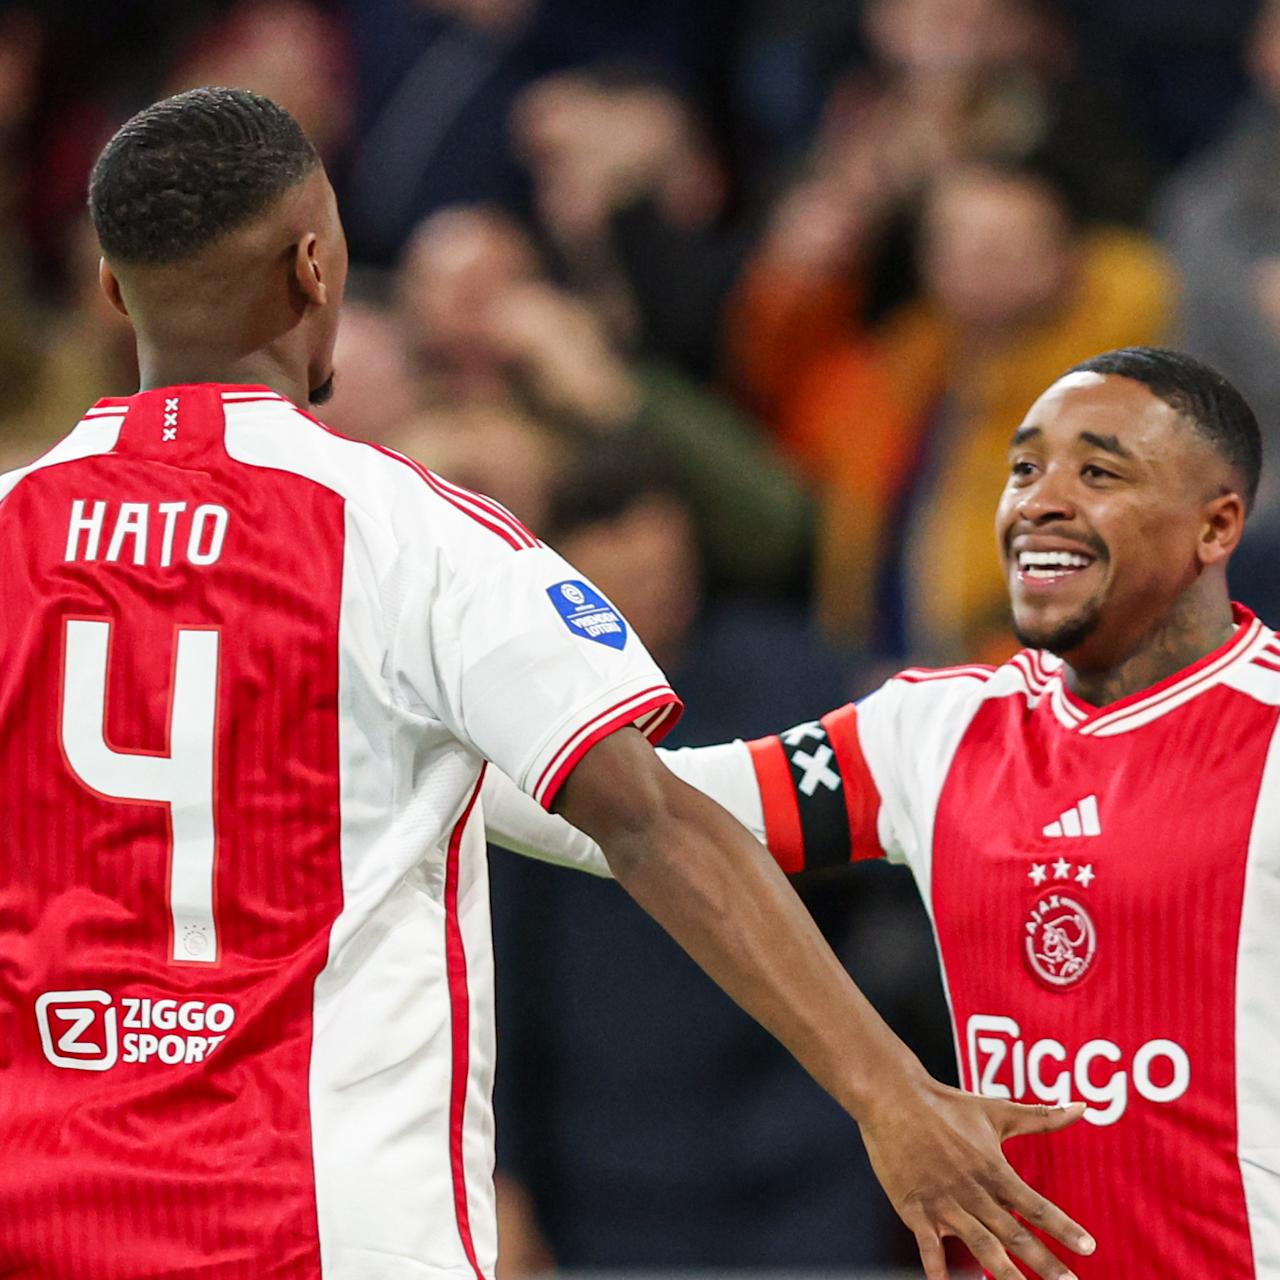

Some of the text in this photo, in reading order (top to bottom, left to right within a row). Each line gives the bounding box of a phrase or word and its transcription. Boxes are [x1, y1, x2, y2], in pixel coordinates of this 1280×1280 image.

[65, 500, 228, 567] HATO
[62, 618, 220, 963] 4
[1025, 895, 1061, 936] AJAX
[121, 998, 235, 1032] ZIGGO
[122, 1033, 227, 1065] SPORT
